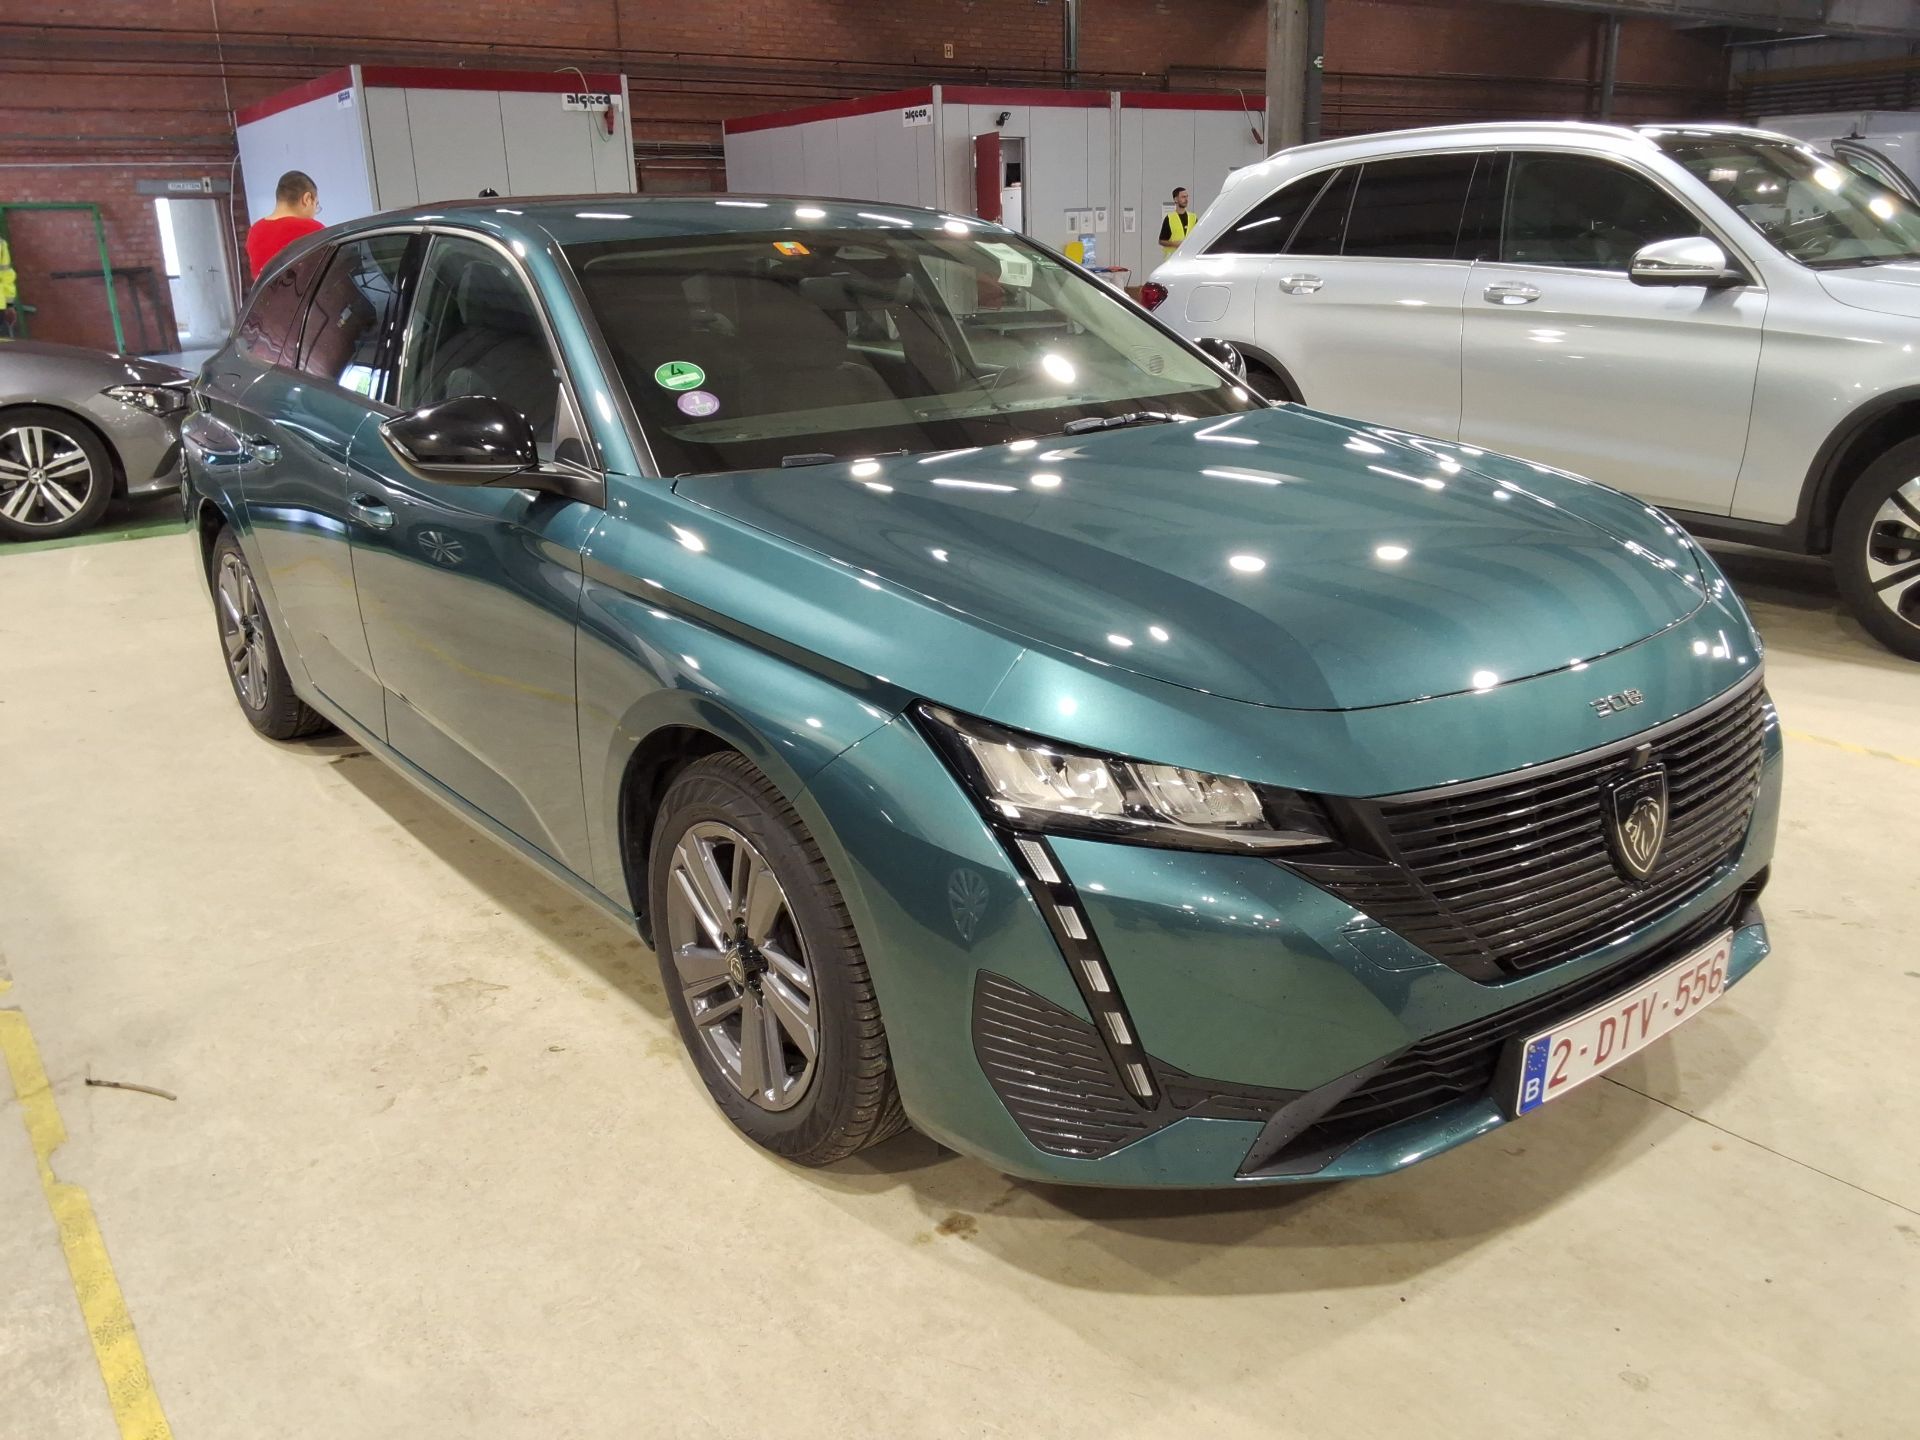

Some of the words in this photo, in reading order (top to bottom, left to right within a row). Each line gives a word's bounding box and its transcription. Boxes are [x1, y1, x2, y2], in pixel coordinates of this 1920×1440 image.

[671, 364, 684, 375] 4
[1589, 690, 1644, 718] 308
[1619, 779, 1661, 800] PEUGEOT
[1547, 950, 1725, 1090] 2-DTV-556
[1524, 1077, 1540, 1103] B
